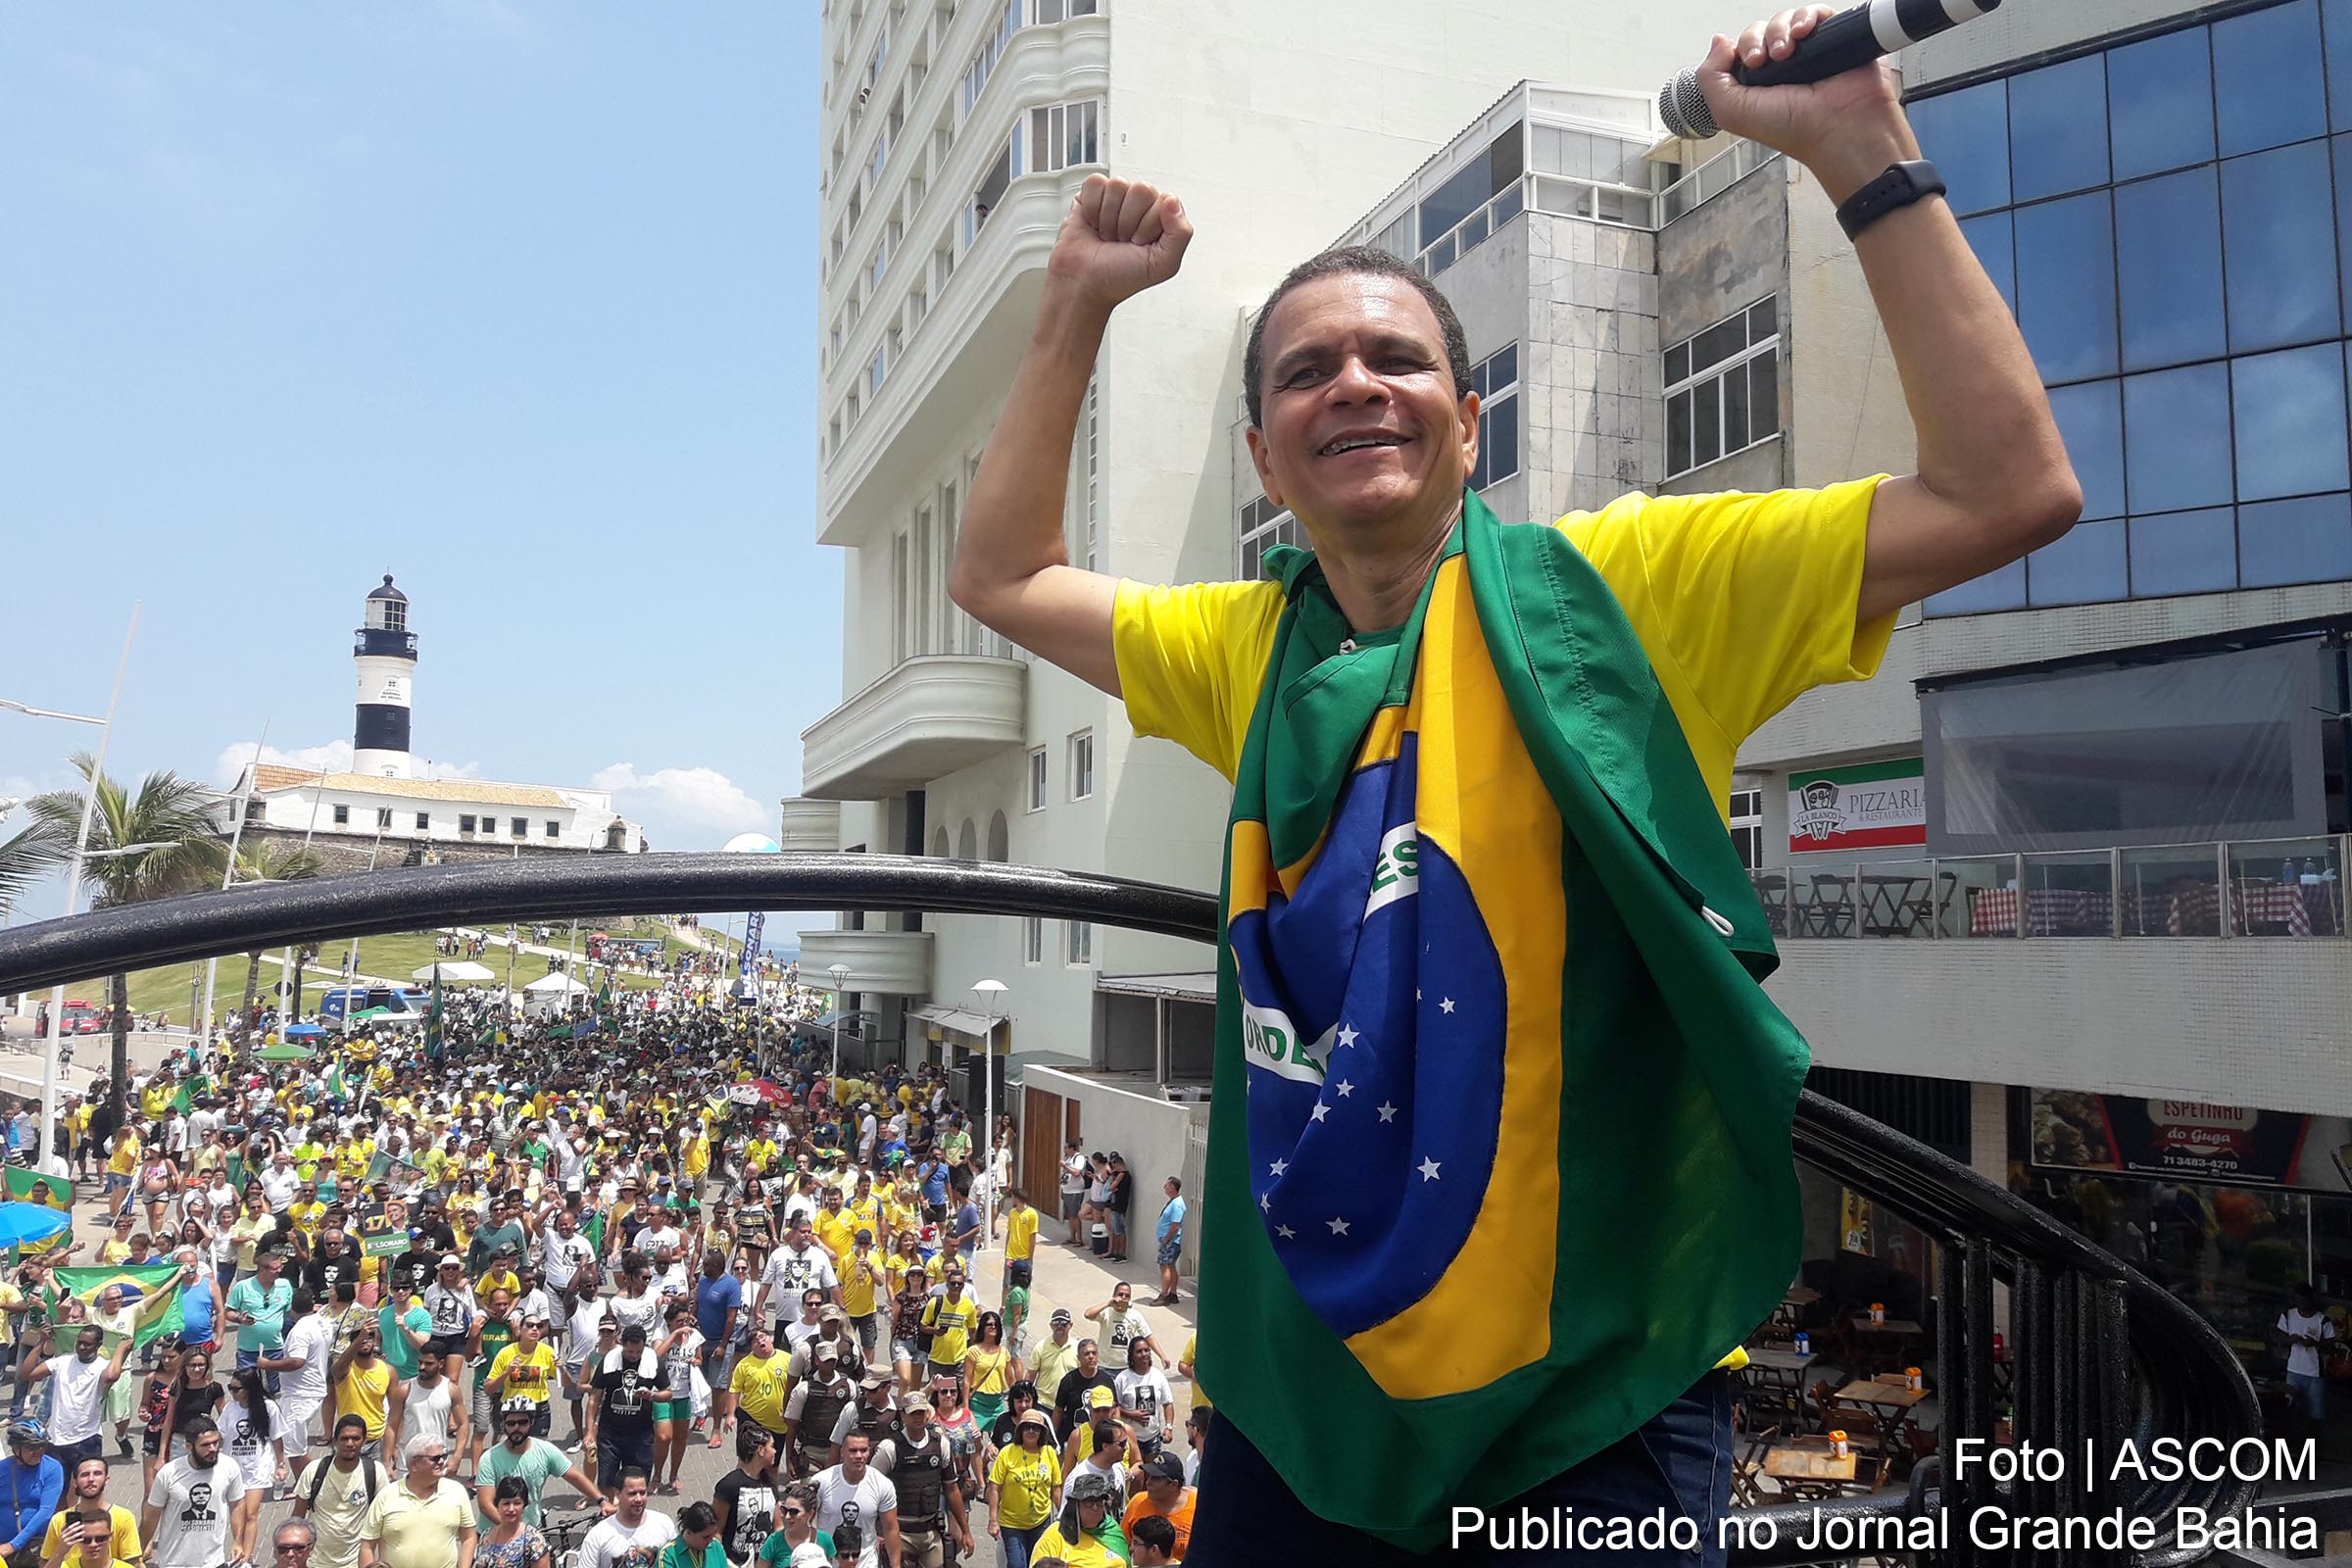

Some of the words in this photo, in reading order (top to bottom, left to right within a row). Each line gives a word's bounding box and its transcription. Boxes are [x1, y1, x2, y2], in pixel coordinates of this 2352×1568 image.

[1810, 810, 1838, 821] BLANCO
[2167, 1128, 2186, 1140] do
[2190, 1129, 2230, 1145] Guga
[2163, 1155, 2175, 1165] 71
[366, 1215, 385, 1231] 17
[760, 1383, 772, 1396] 10
